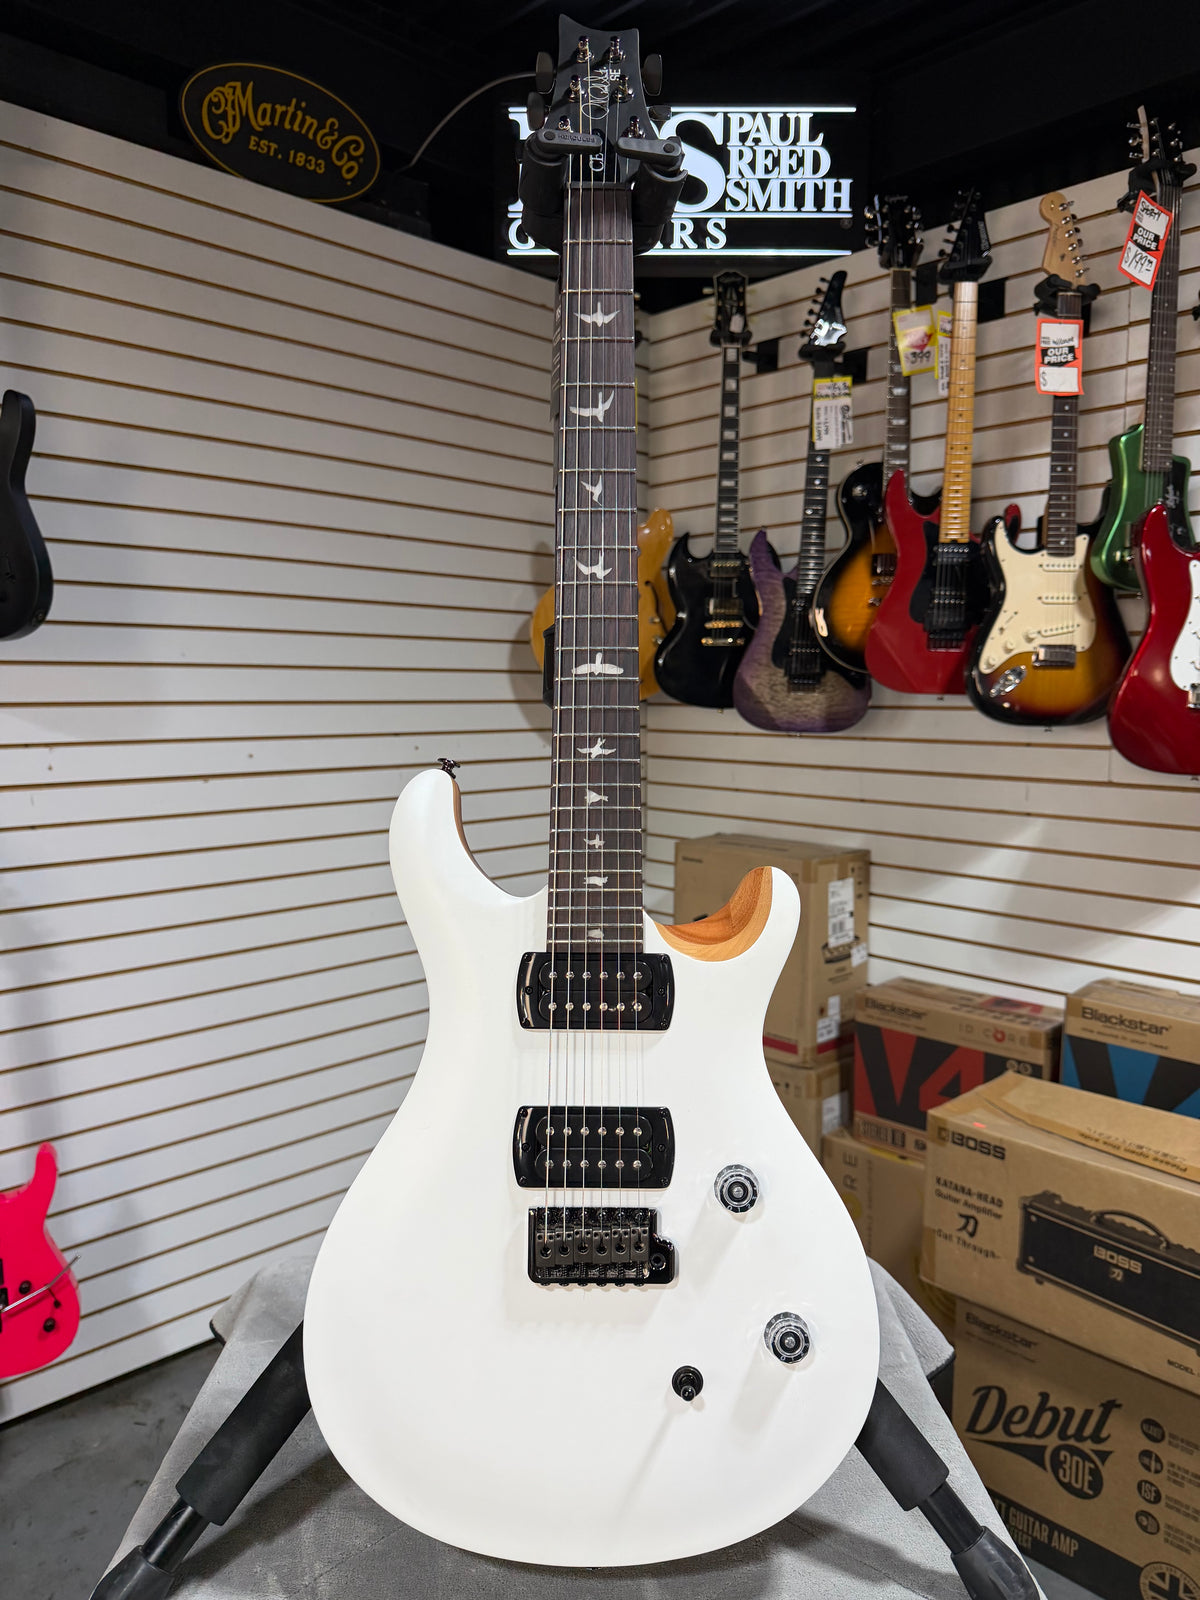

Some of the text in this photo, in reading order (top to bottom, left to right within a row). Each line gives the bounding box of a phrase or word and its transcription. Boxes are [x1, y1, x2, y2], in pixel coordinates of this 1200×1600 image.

[610, 68, 621, 81] SE
[727, 112, 824, 146] PAUL
[248, 136, 326, 174] EST. 1833
[727, 146, 831, 179] REED
[725, 178, 853, 212] SMITH
[1133, 233, 1158, 251] PRICE
[1137, 227, 1155, 241] OUR
[1044, 353, 1075, 364] PRICE
[1047, 347, 1069, 356] OUR
[864, 998, 928, 1020] Blackstar
[1081, 1006, 1169, 1035] Blackstar
[950, 1130, 1006, 1160] BOSS
[935, 1176, 1004, 1208] KATANA-HEAD
[935, 1188, 1003, 1220] Guitar Amplifier
[1093, 1245, 1143, 1274] BOSS
[965, 1312, 1039, 1349] Blackstar
[964, 1385, 1123, 1444] Debut
[1057, 1448, 1096, 1496] 30E
[1141, 1481, 1157, 1502] ISF
[1008, 1506, 1049, 1544] GUITAR
[1050, 1530, 1079, 1557] AMP
